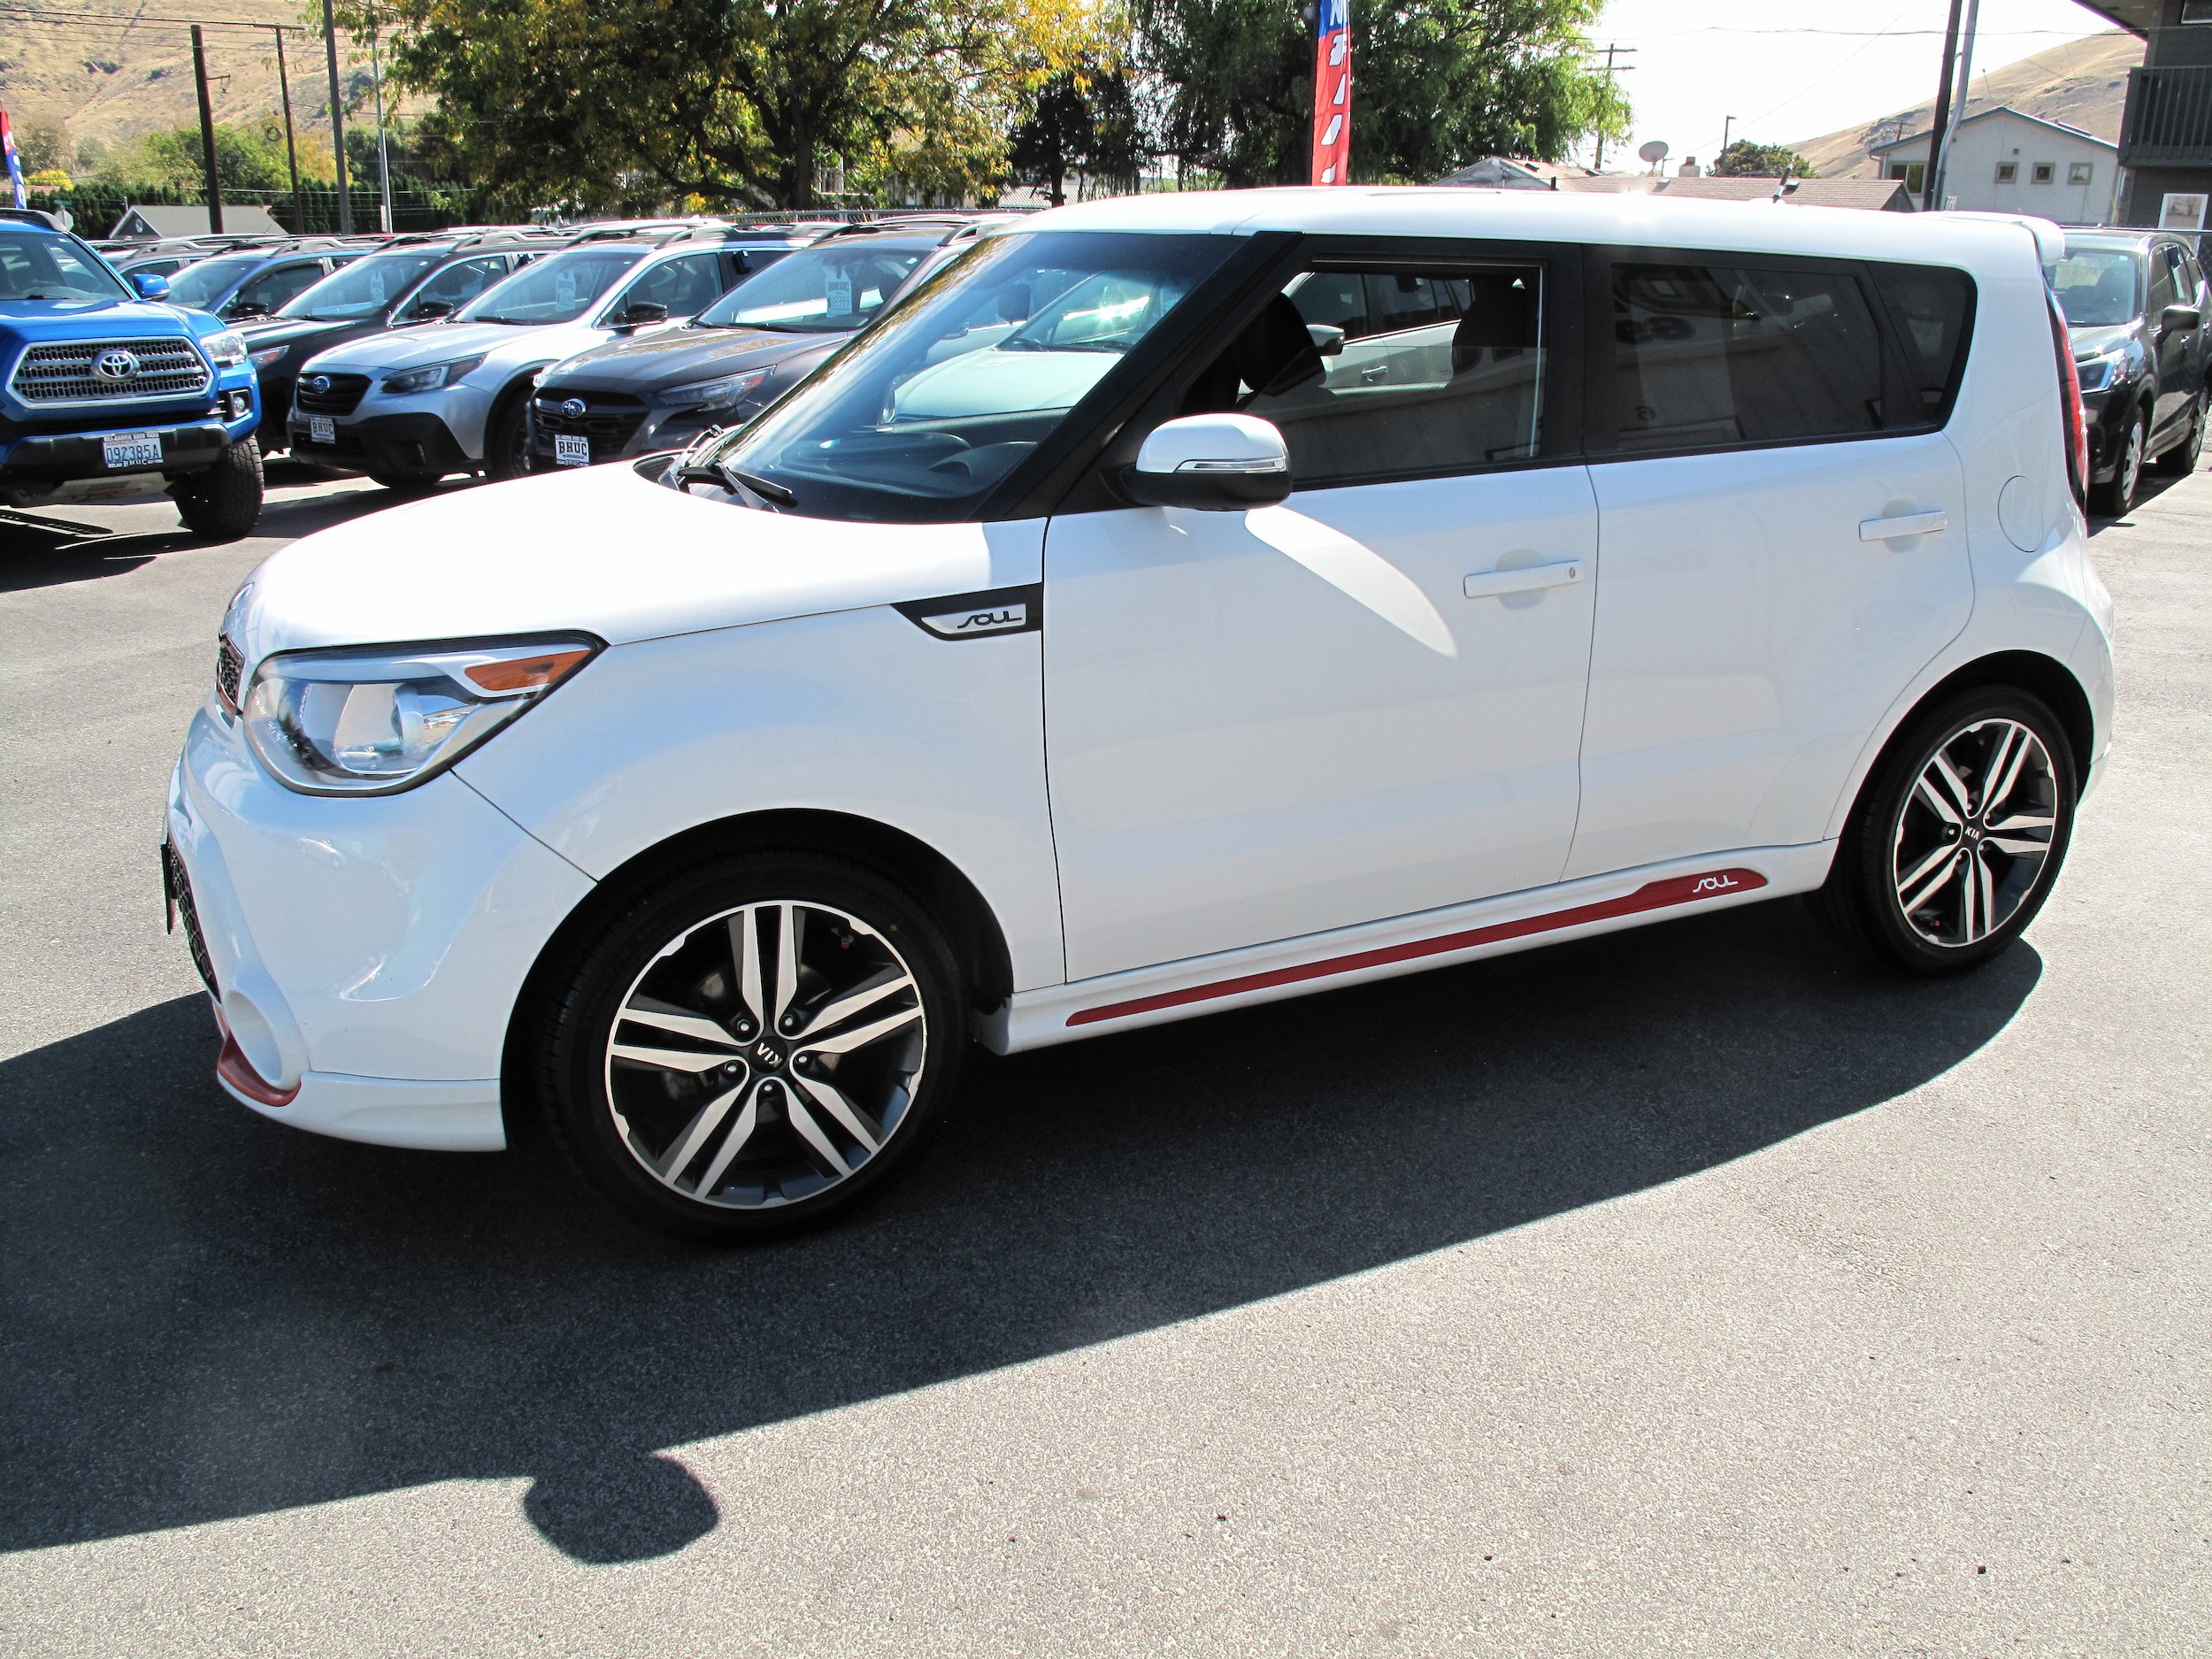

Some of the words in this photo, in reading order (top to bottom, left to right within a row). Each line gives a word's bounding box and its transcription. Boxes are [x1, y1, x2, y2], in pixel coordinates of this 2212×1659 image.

[312, 421, 334, 434] BHUC
[558, 441, 588, 457] BHUC
[956, 611, 1023, 629] SOUL
[1964, 826, 1980, 841] KIA
[1692, 874, 1739, 894] SOUL
[757, 1041, 784, 1069] KIA
